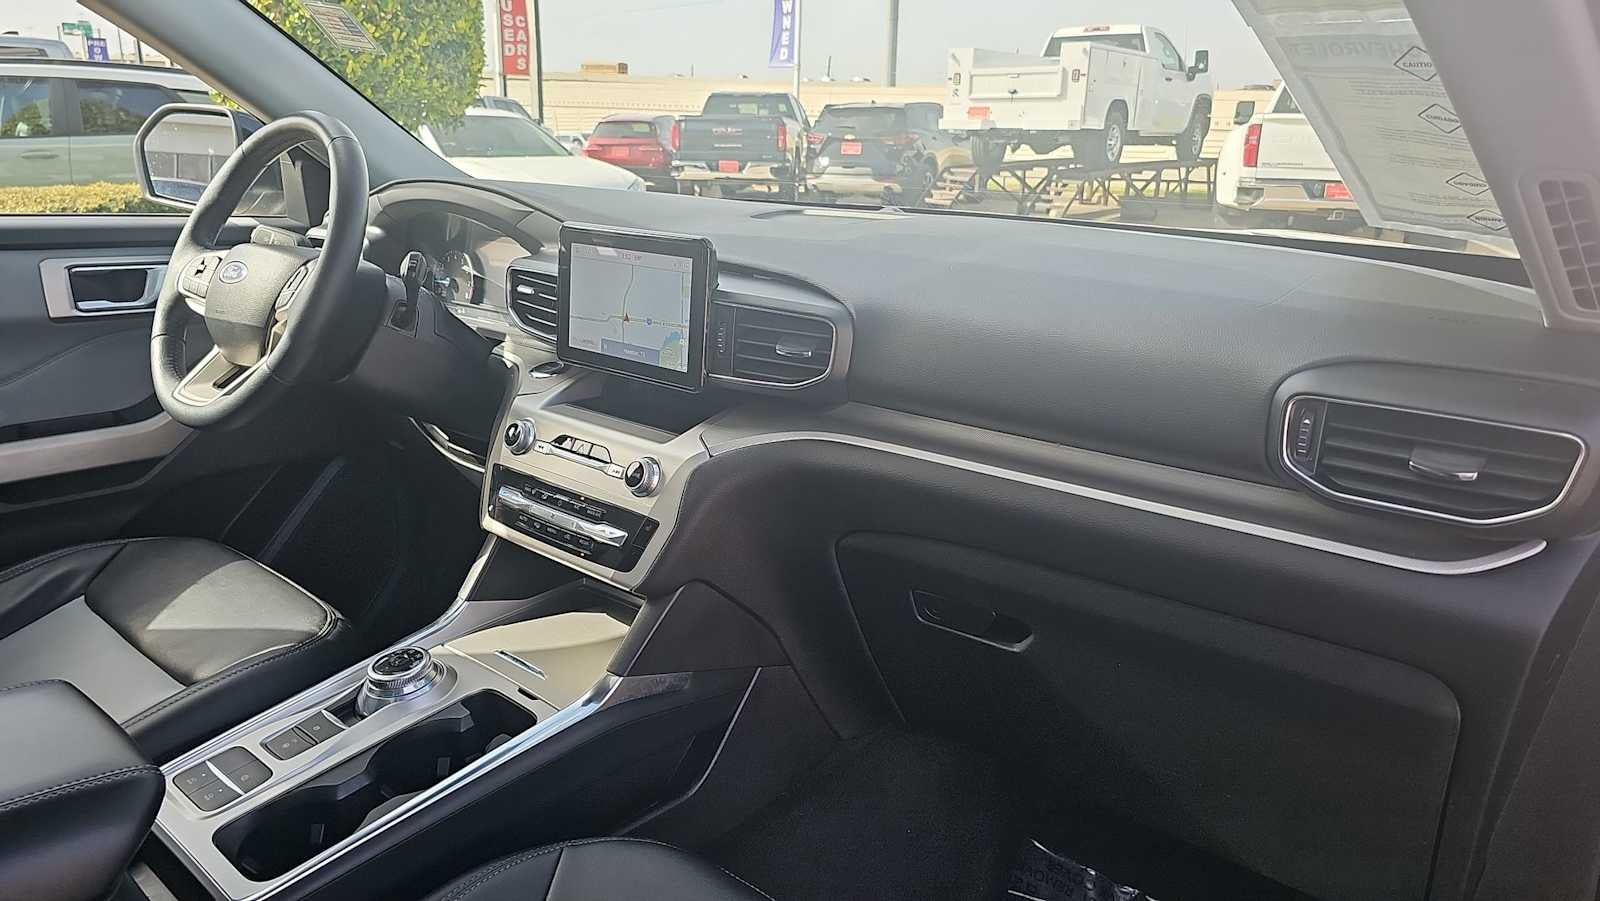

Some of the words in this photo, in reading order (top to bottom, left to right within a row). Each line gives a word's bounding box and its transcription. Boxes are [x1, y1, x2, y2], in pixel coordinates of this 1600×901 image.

[500, 0, 516, 57] USED
[515, 15, 528, 70] CARS
[1402, 61, 1433, 69] CAUTIO
